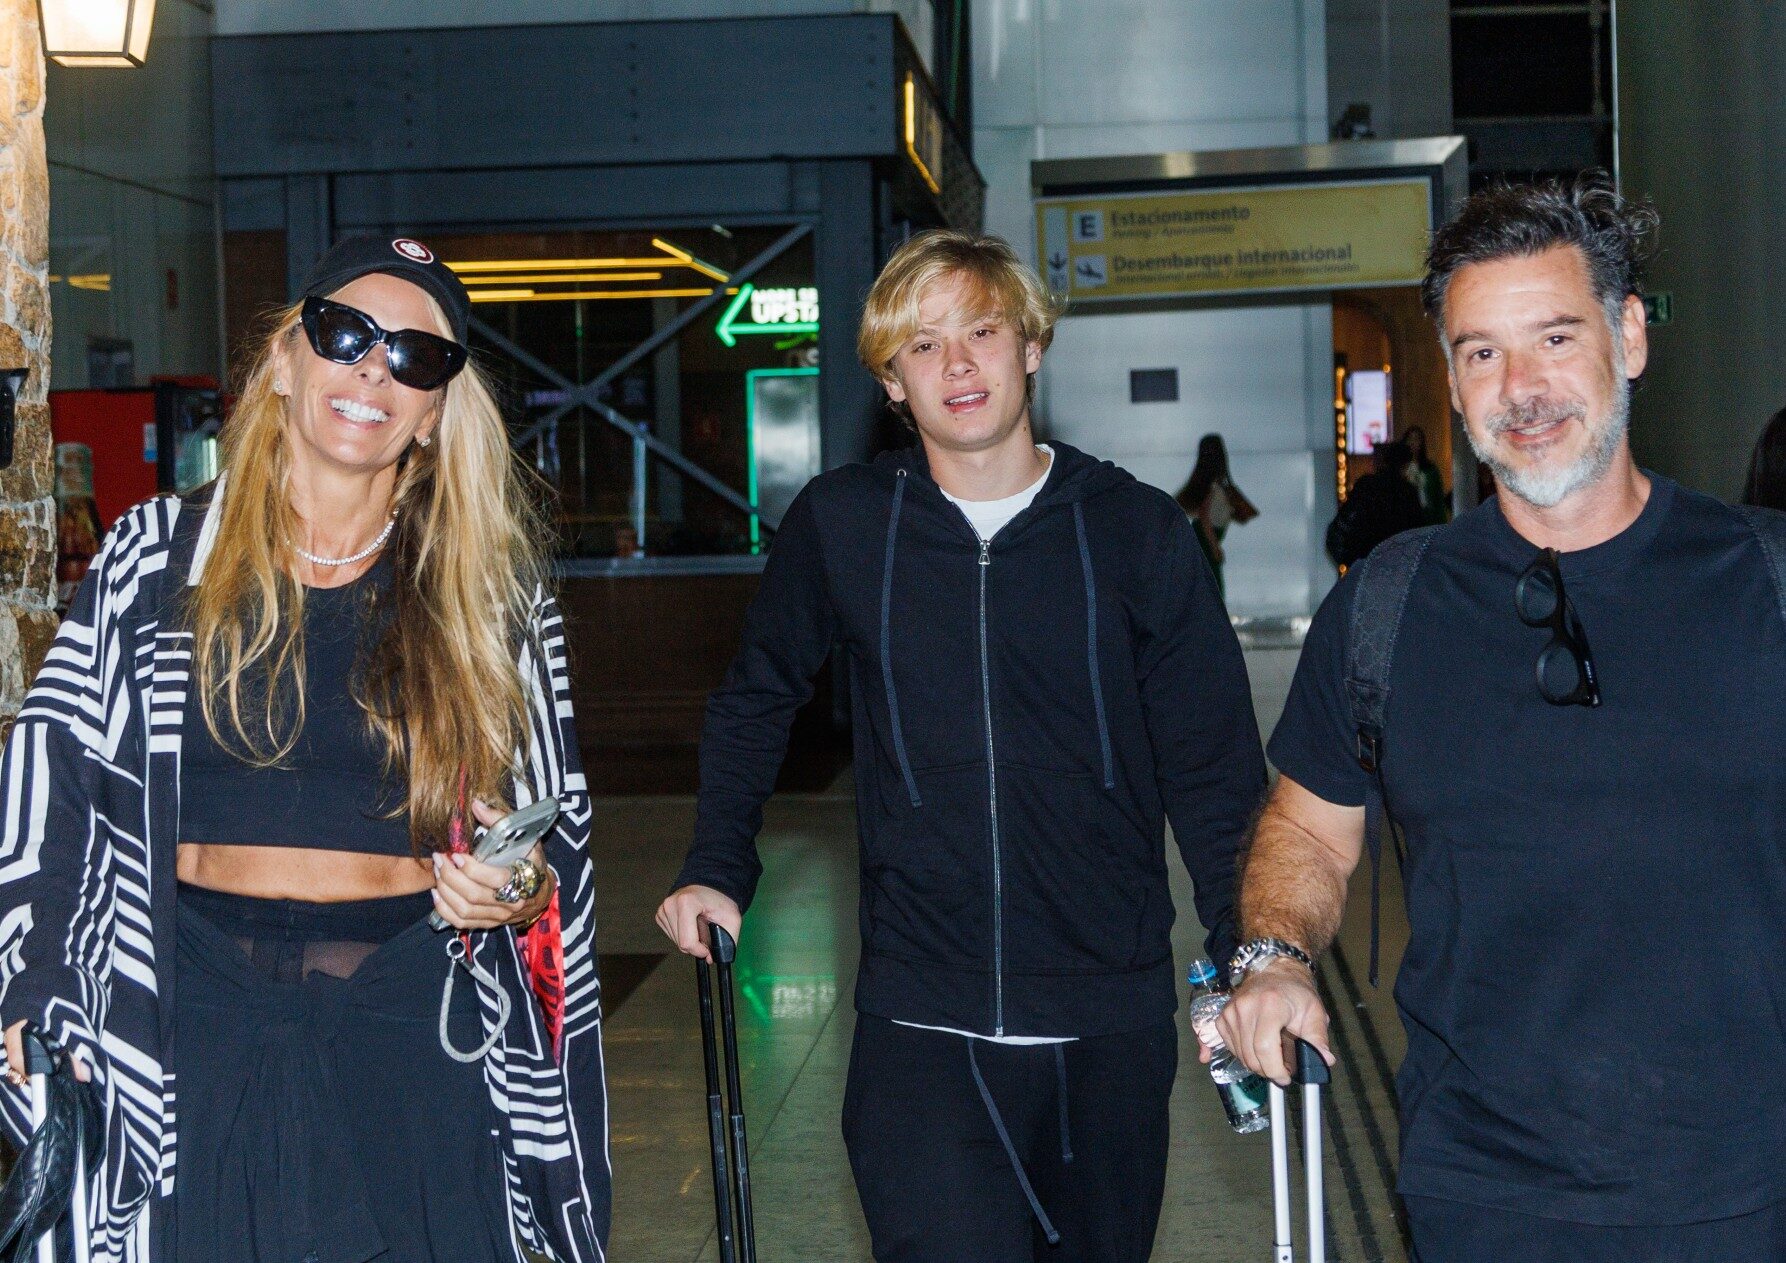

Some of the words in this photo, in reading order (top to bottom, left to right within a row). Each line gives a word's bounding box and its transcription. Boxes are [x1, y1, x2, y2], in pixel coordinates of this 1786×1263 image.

[1079, 213, 1098, 238] E
[1111, 204, 1250, 228] Estacionamento
[1112, 251, 1233, 273] Desembarque
